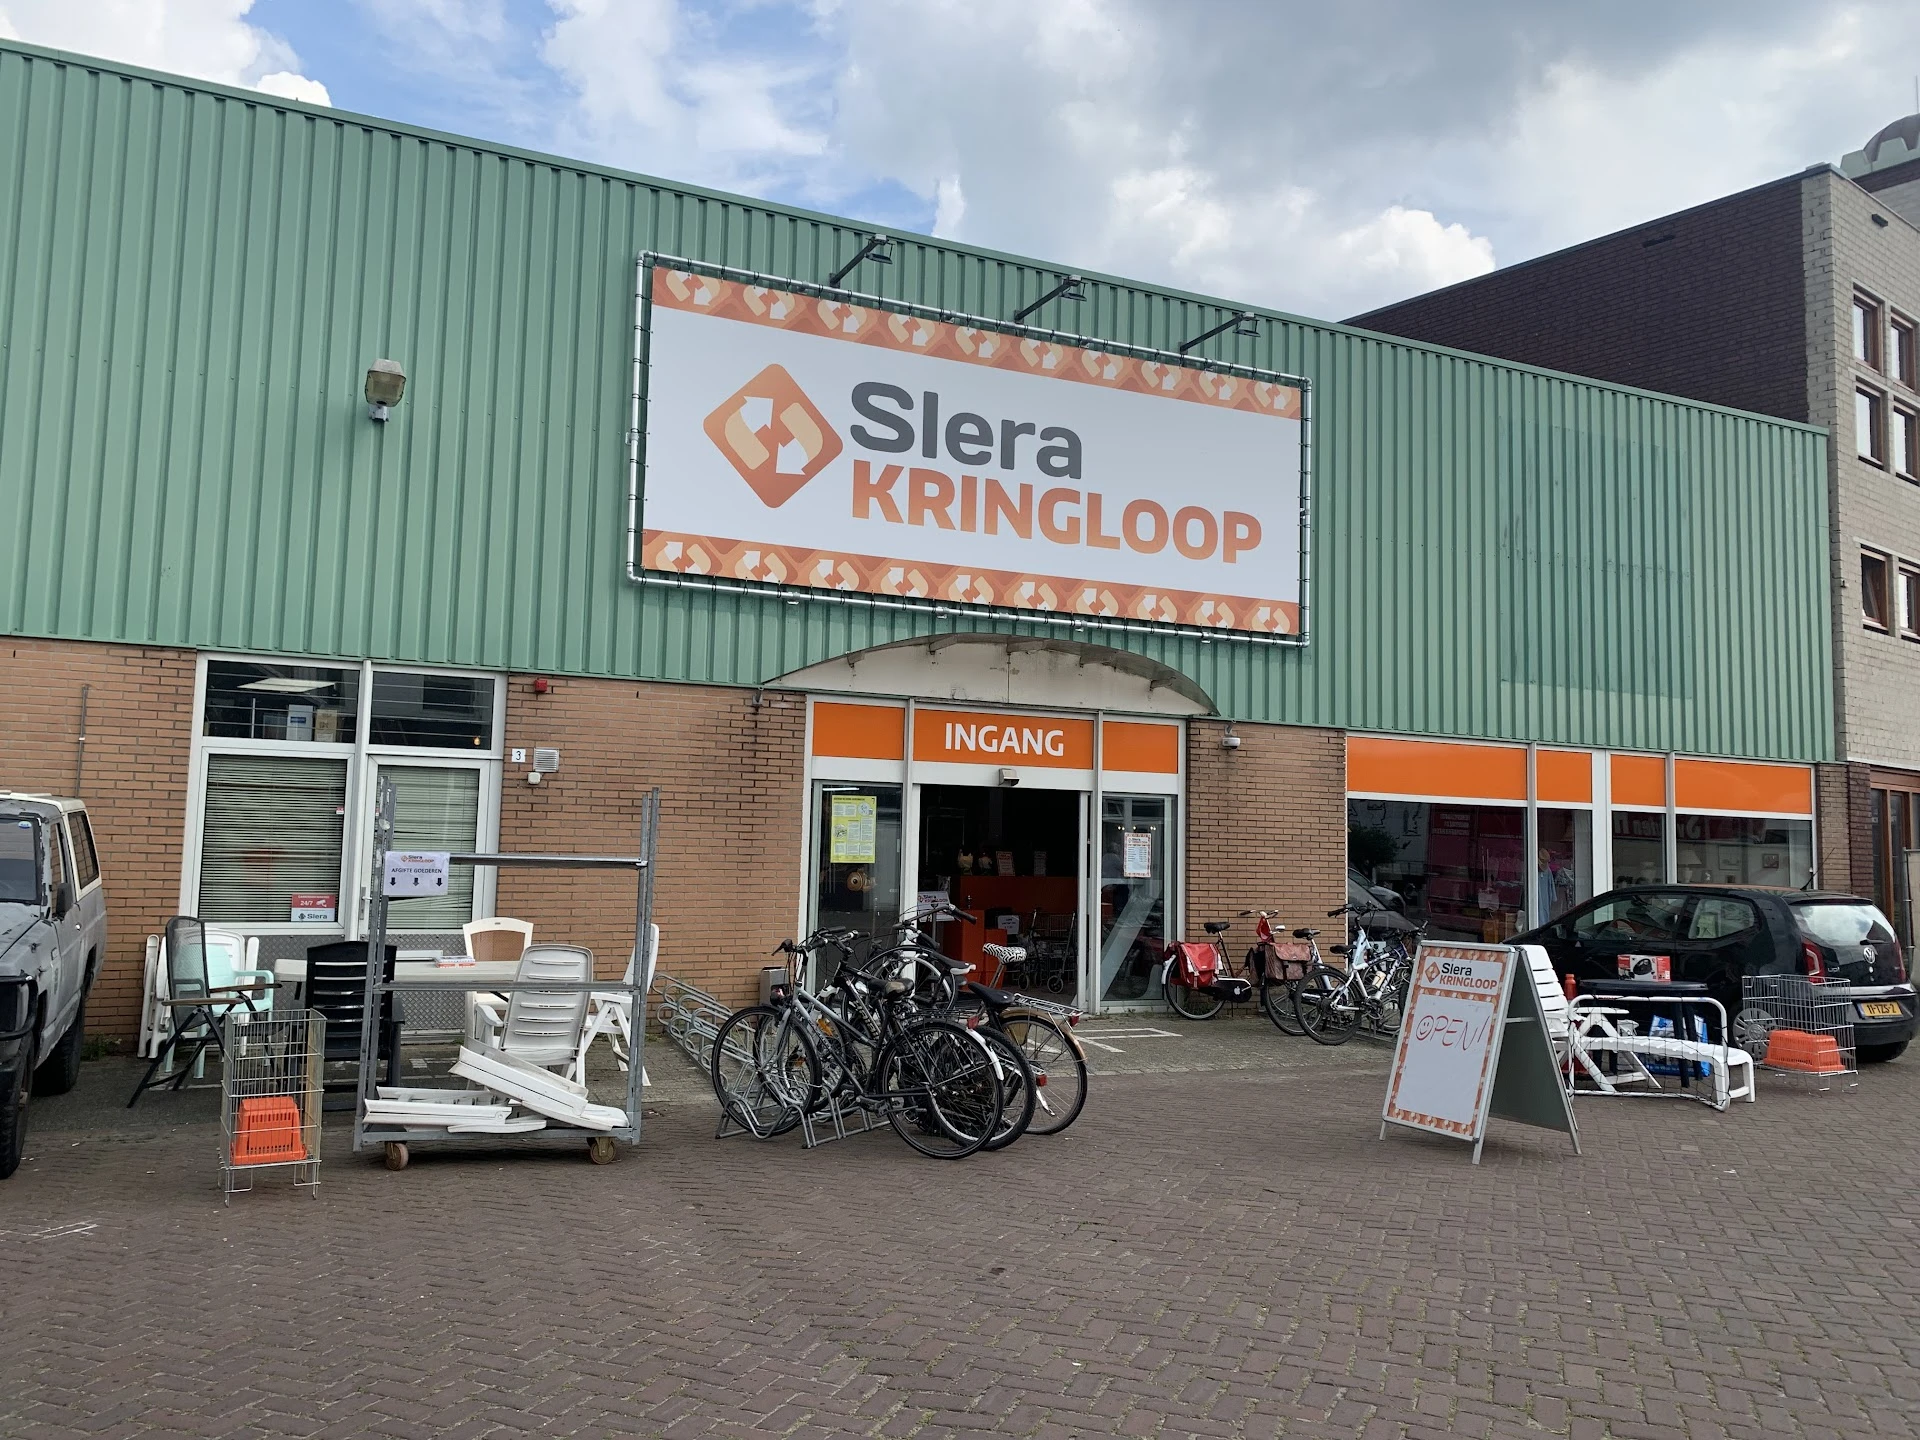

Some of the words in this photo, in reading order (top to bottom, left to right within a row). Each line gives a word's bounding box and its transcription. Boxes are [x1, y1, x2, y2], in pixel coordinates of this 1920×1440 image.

[852, 459, 1262, 564] KRINGLOOP
[945, 722, 1064, 757] INGANG
[516, 750, 521, 760] 3
[1439, 976, 1498, 990] KRINGLOOP
